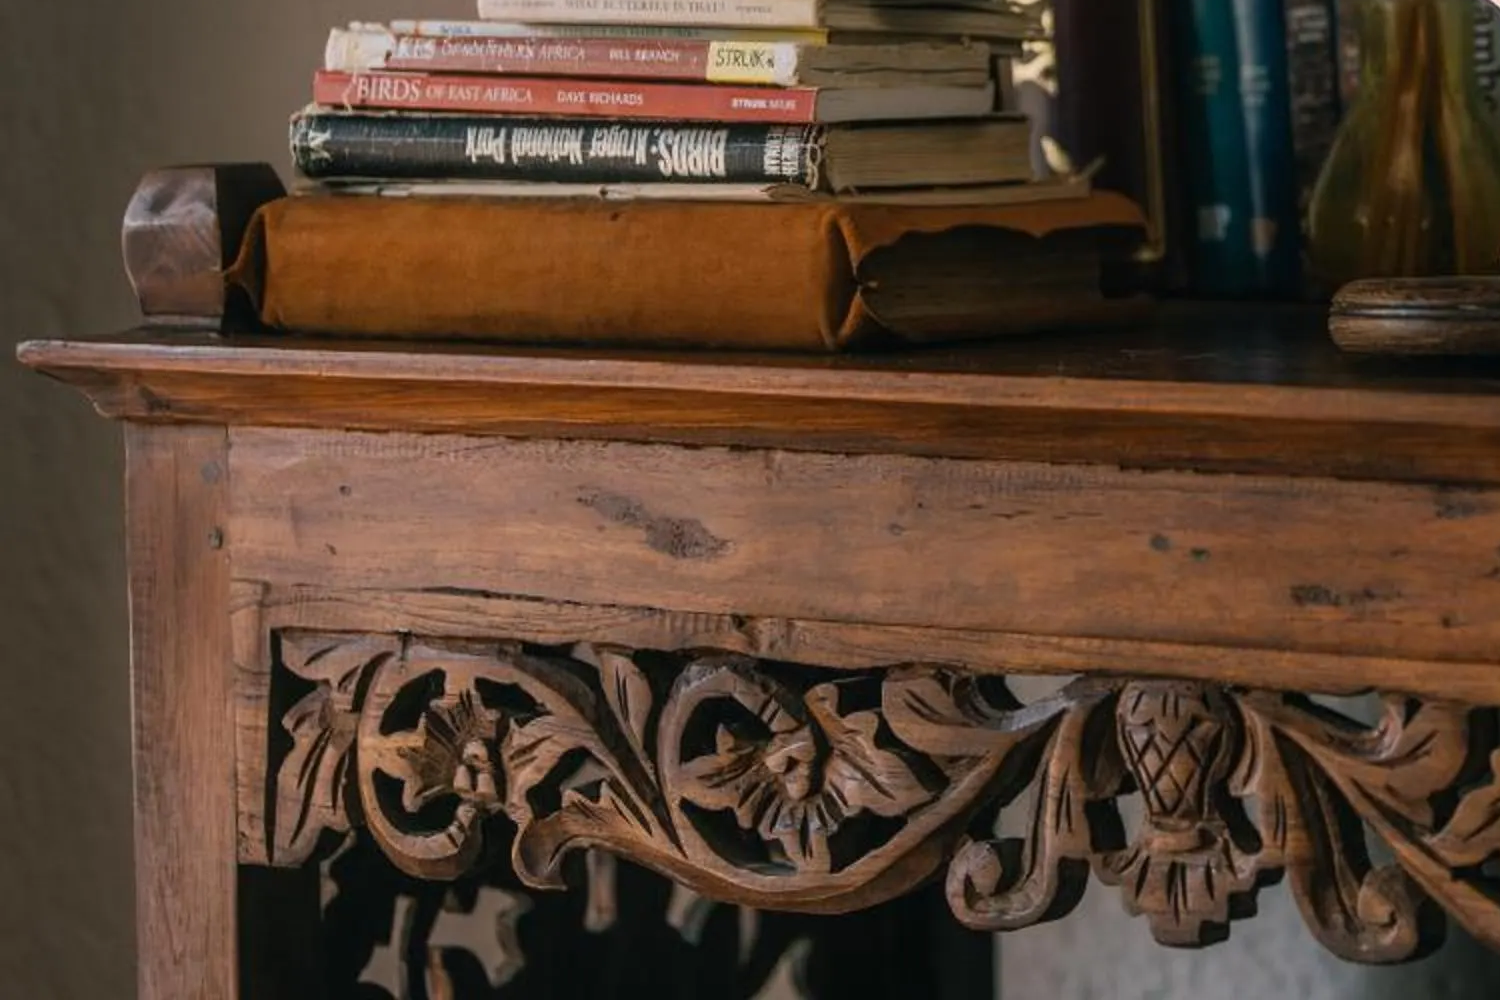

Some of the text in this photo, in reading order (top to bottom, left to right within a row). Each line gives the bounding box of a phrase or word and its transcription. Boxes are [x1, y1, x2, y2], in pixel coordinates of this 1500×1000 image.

[537, 43, 585, 61] AFRICA
[634, 48, 680, 63] BRANCH
[356, 76, 532, 102] BIRDS OF EAST AFRICA
[556, 91, 644, 106] DAVE RICHARDS
[465, 125, 507, 164] Park
[510, 126, 585, 166] National
[590, 124, 650, 165] Kruger
[651, 127, 729, 177] BIRDS:
